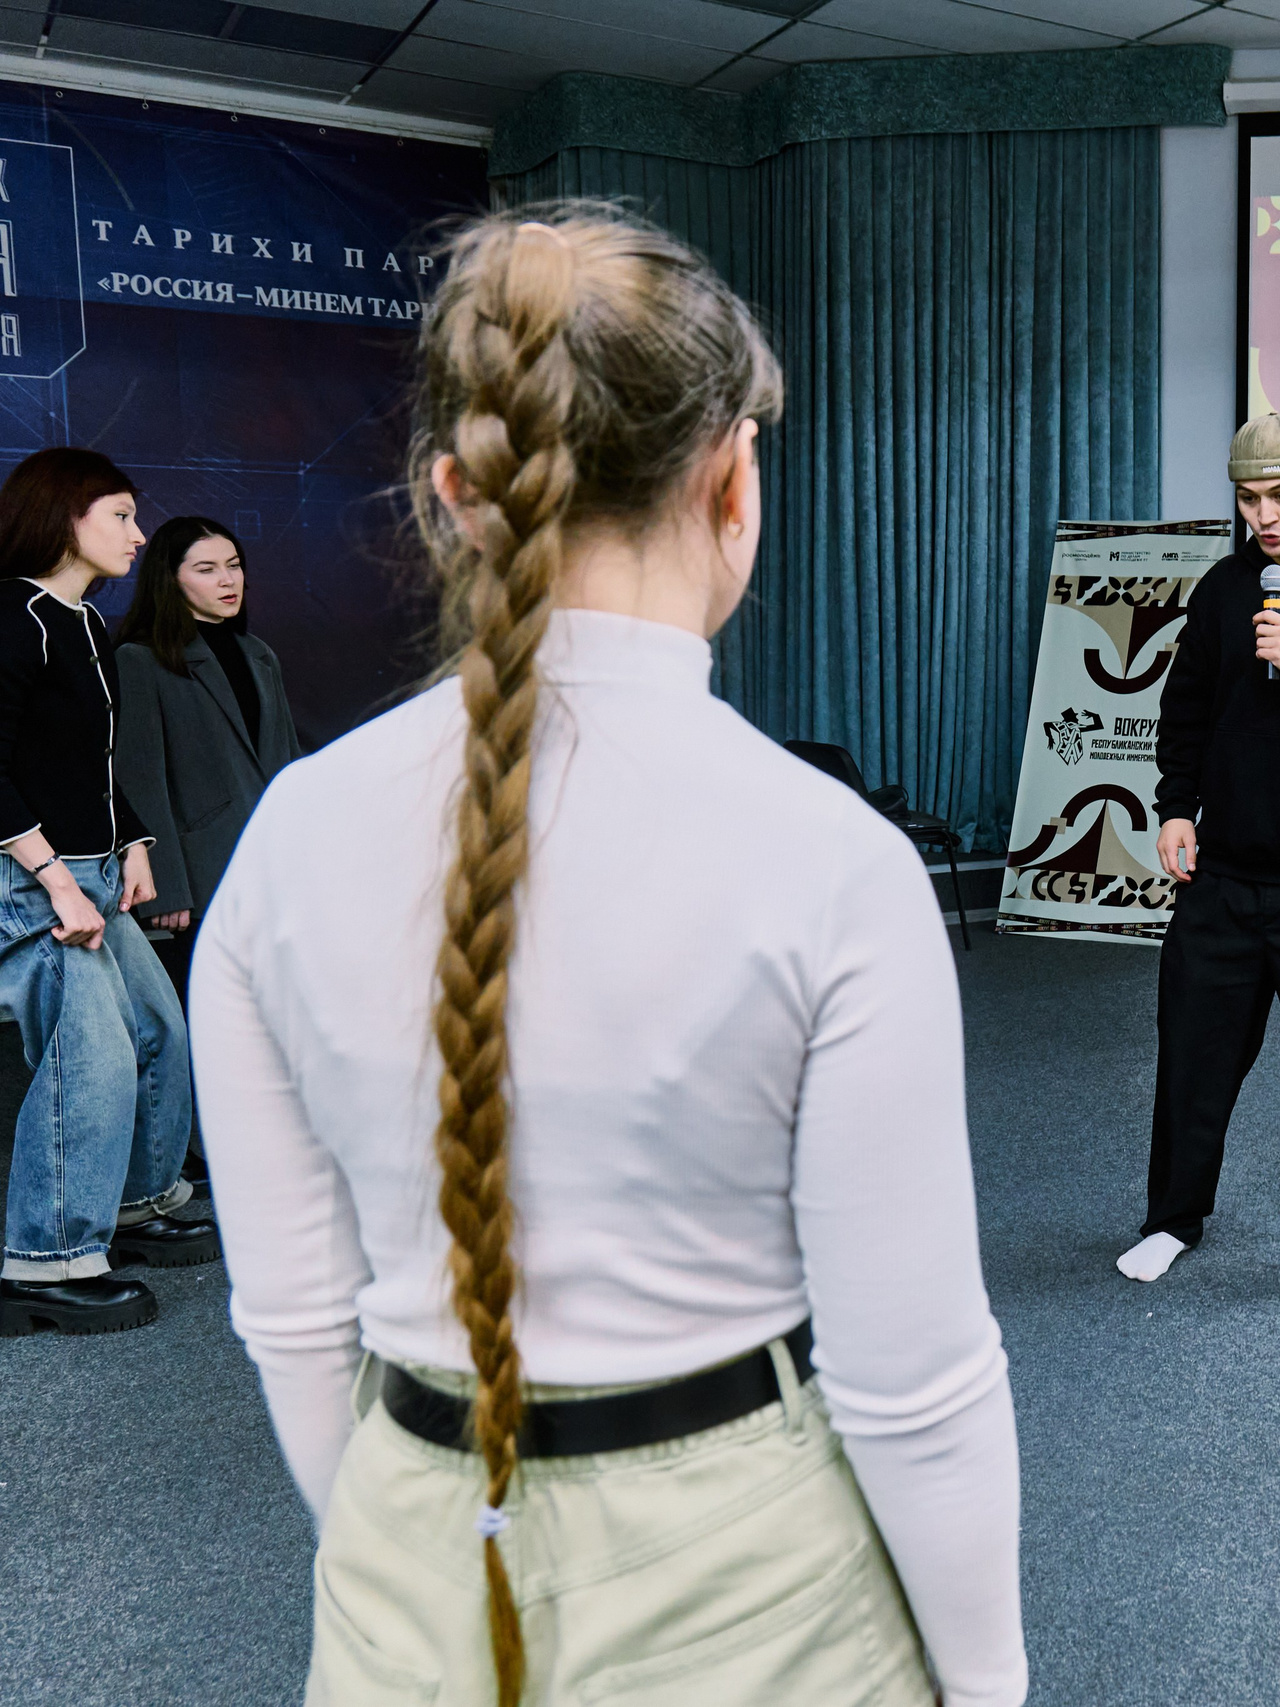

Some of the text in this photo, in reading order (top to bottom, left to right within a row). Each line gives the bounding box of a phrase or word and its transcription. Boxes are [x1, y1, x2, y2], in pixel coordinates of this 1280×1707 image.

[92, 219, 435, 276] ТАРИХИ ПАР
[367, 297, 439, 321] ТАРИ
